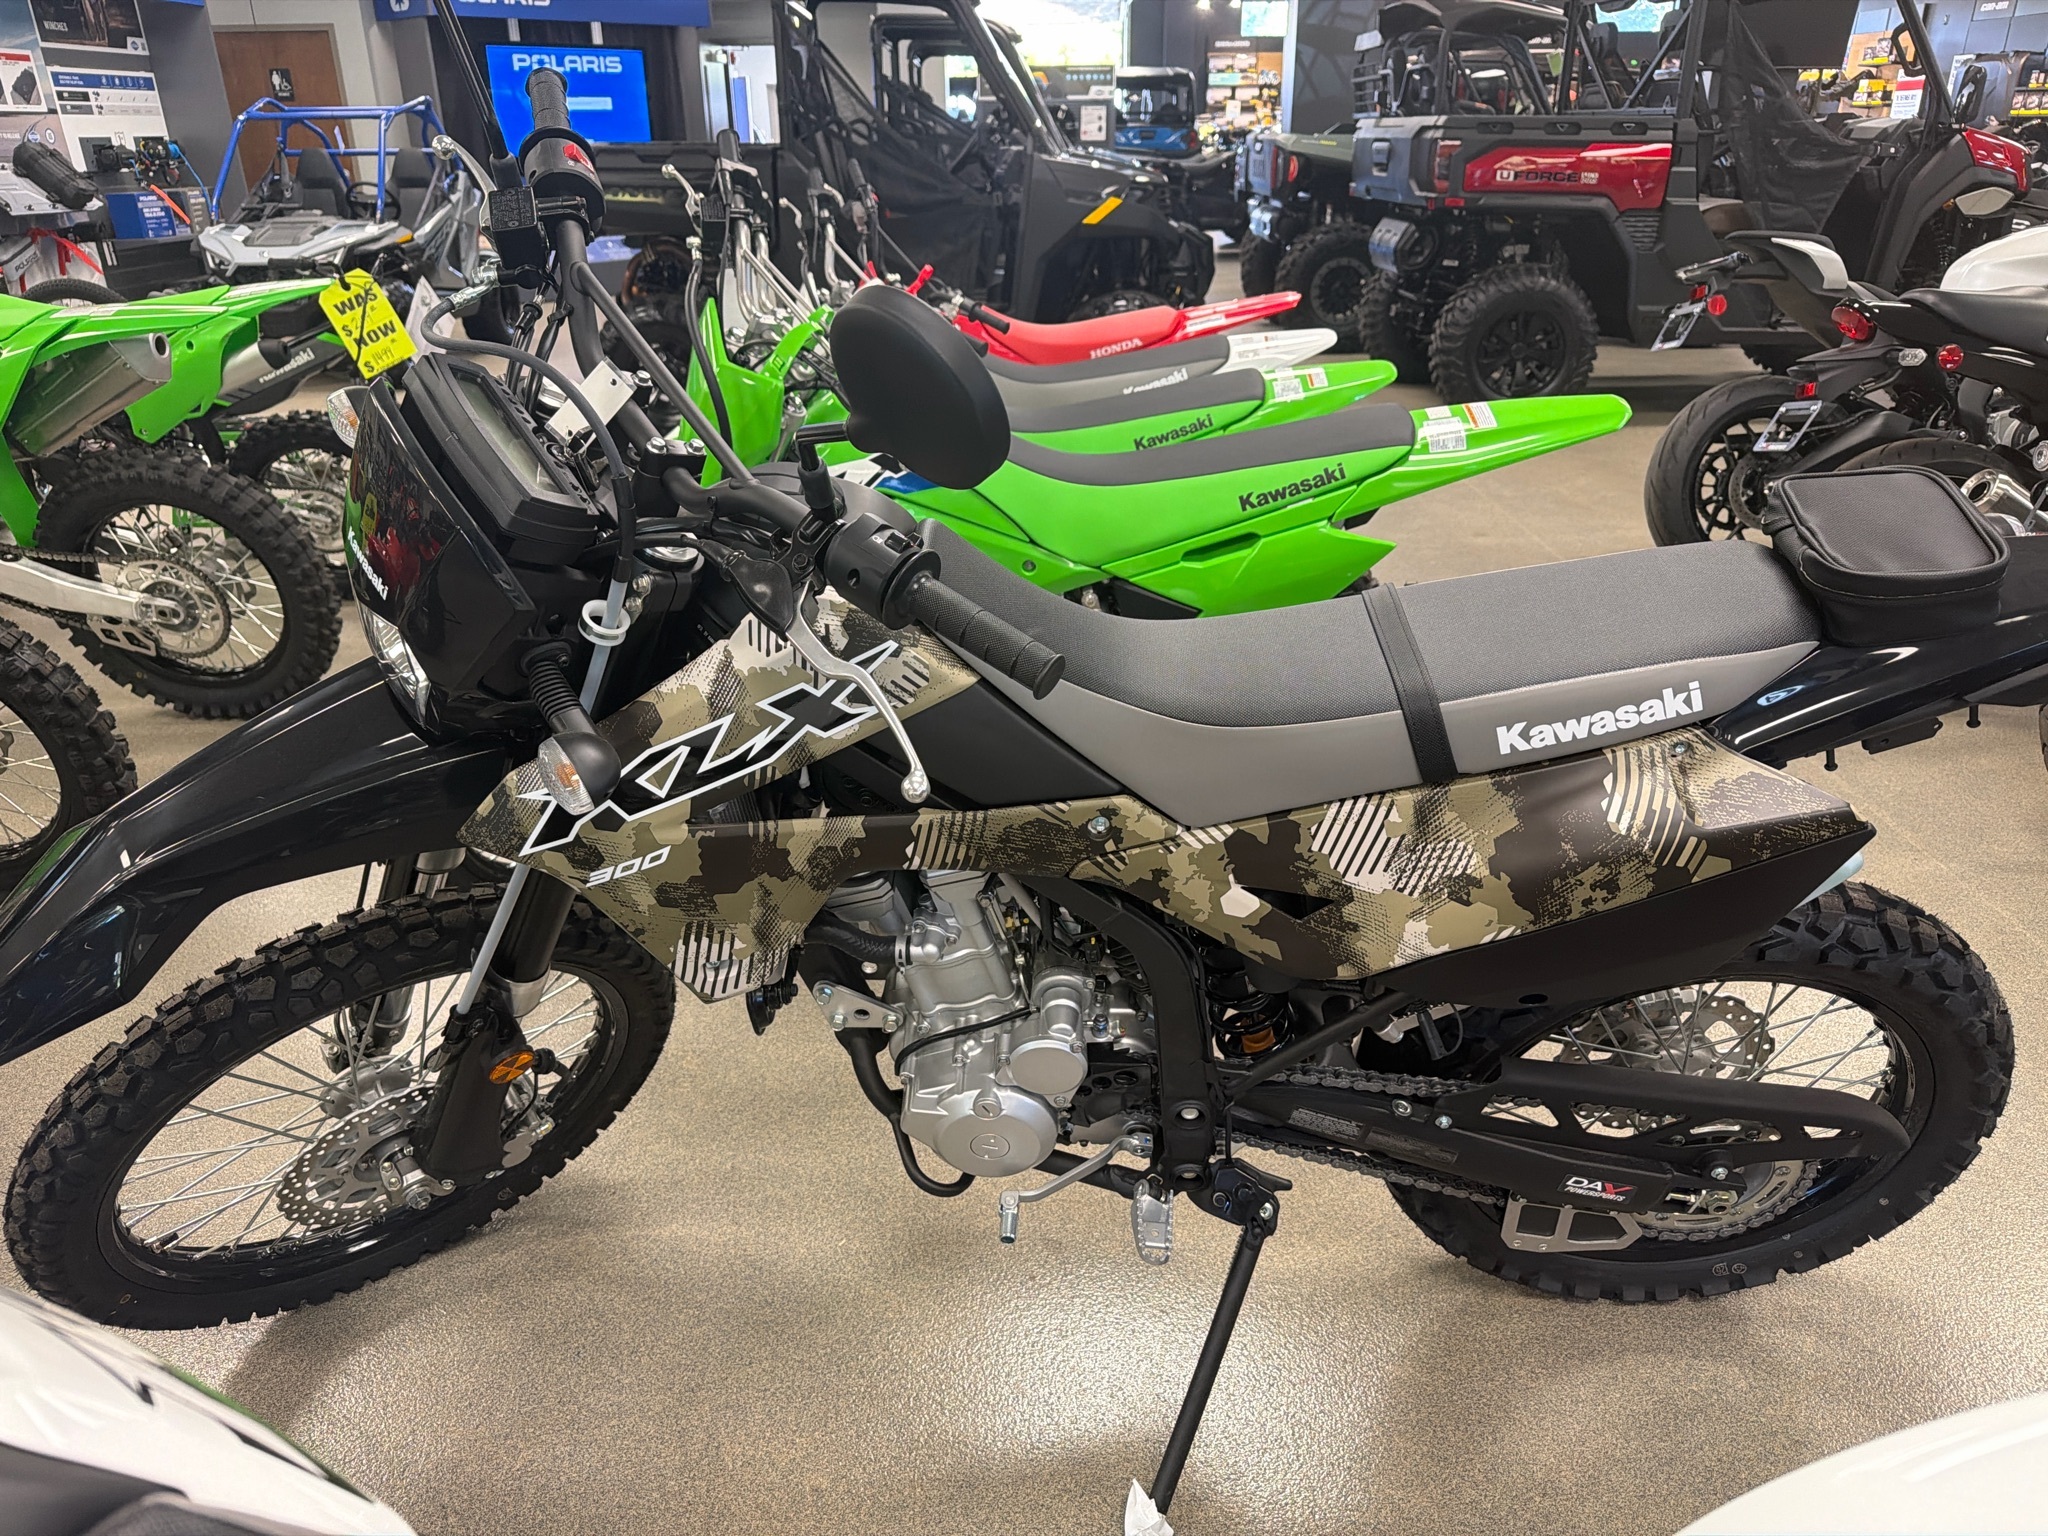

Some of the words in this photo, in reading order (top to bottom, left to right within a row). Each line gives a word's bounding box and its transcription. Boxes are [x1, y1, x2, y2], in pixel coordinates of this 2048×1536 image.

[512, 52, 623, 73] POLARIS
[333, 286, 378, 316] WAS
[353, 320, 397, 347] NOW
[1089, 338, 1143, 360] HONDA
[1133, 414, 1214, 452] Kawasaki
[1238, 462, 1347, 512] Kawasaki
[346, 525, 390, 601] Kawasaki
[1496, 680, 1704, 756] Kawasaki
[586, 844, 672, 888] 300
[1564, 1186, 1627, 1202] POWERSPORTS
[1565, 1176, 1634, 1196] DAX
